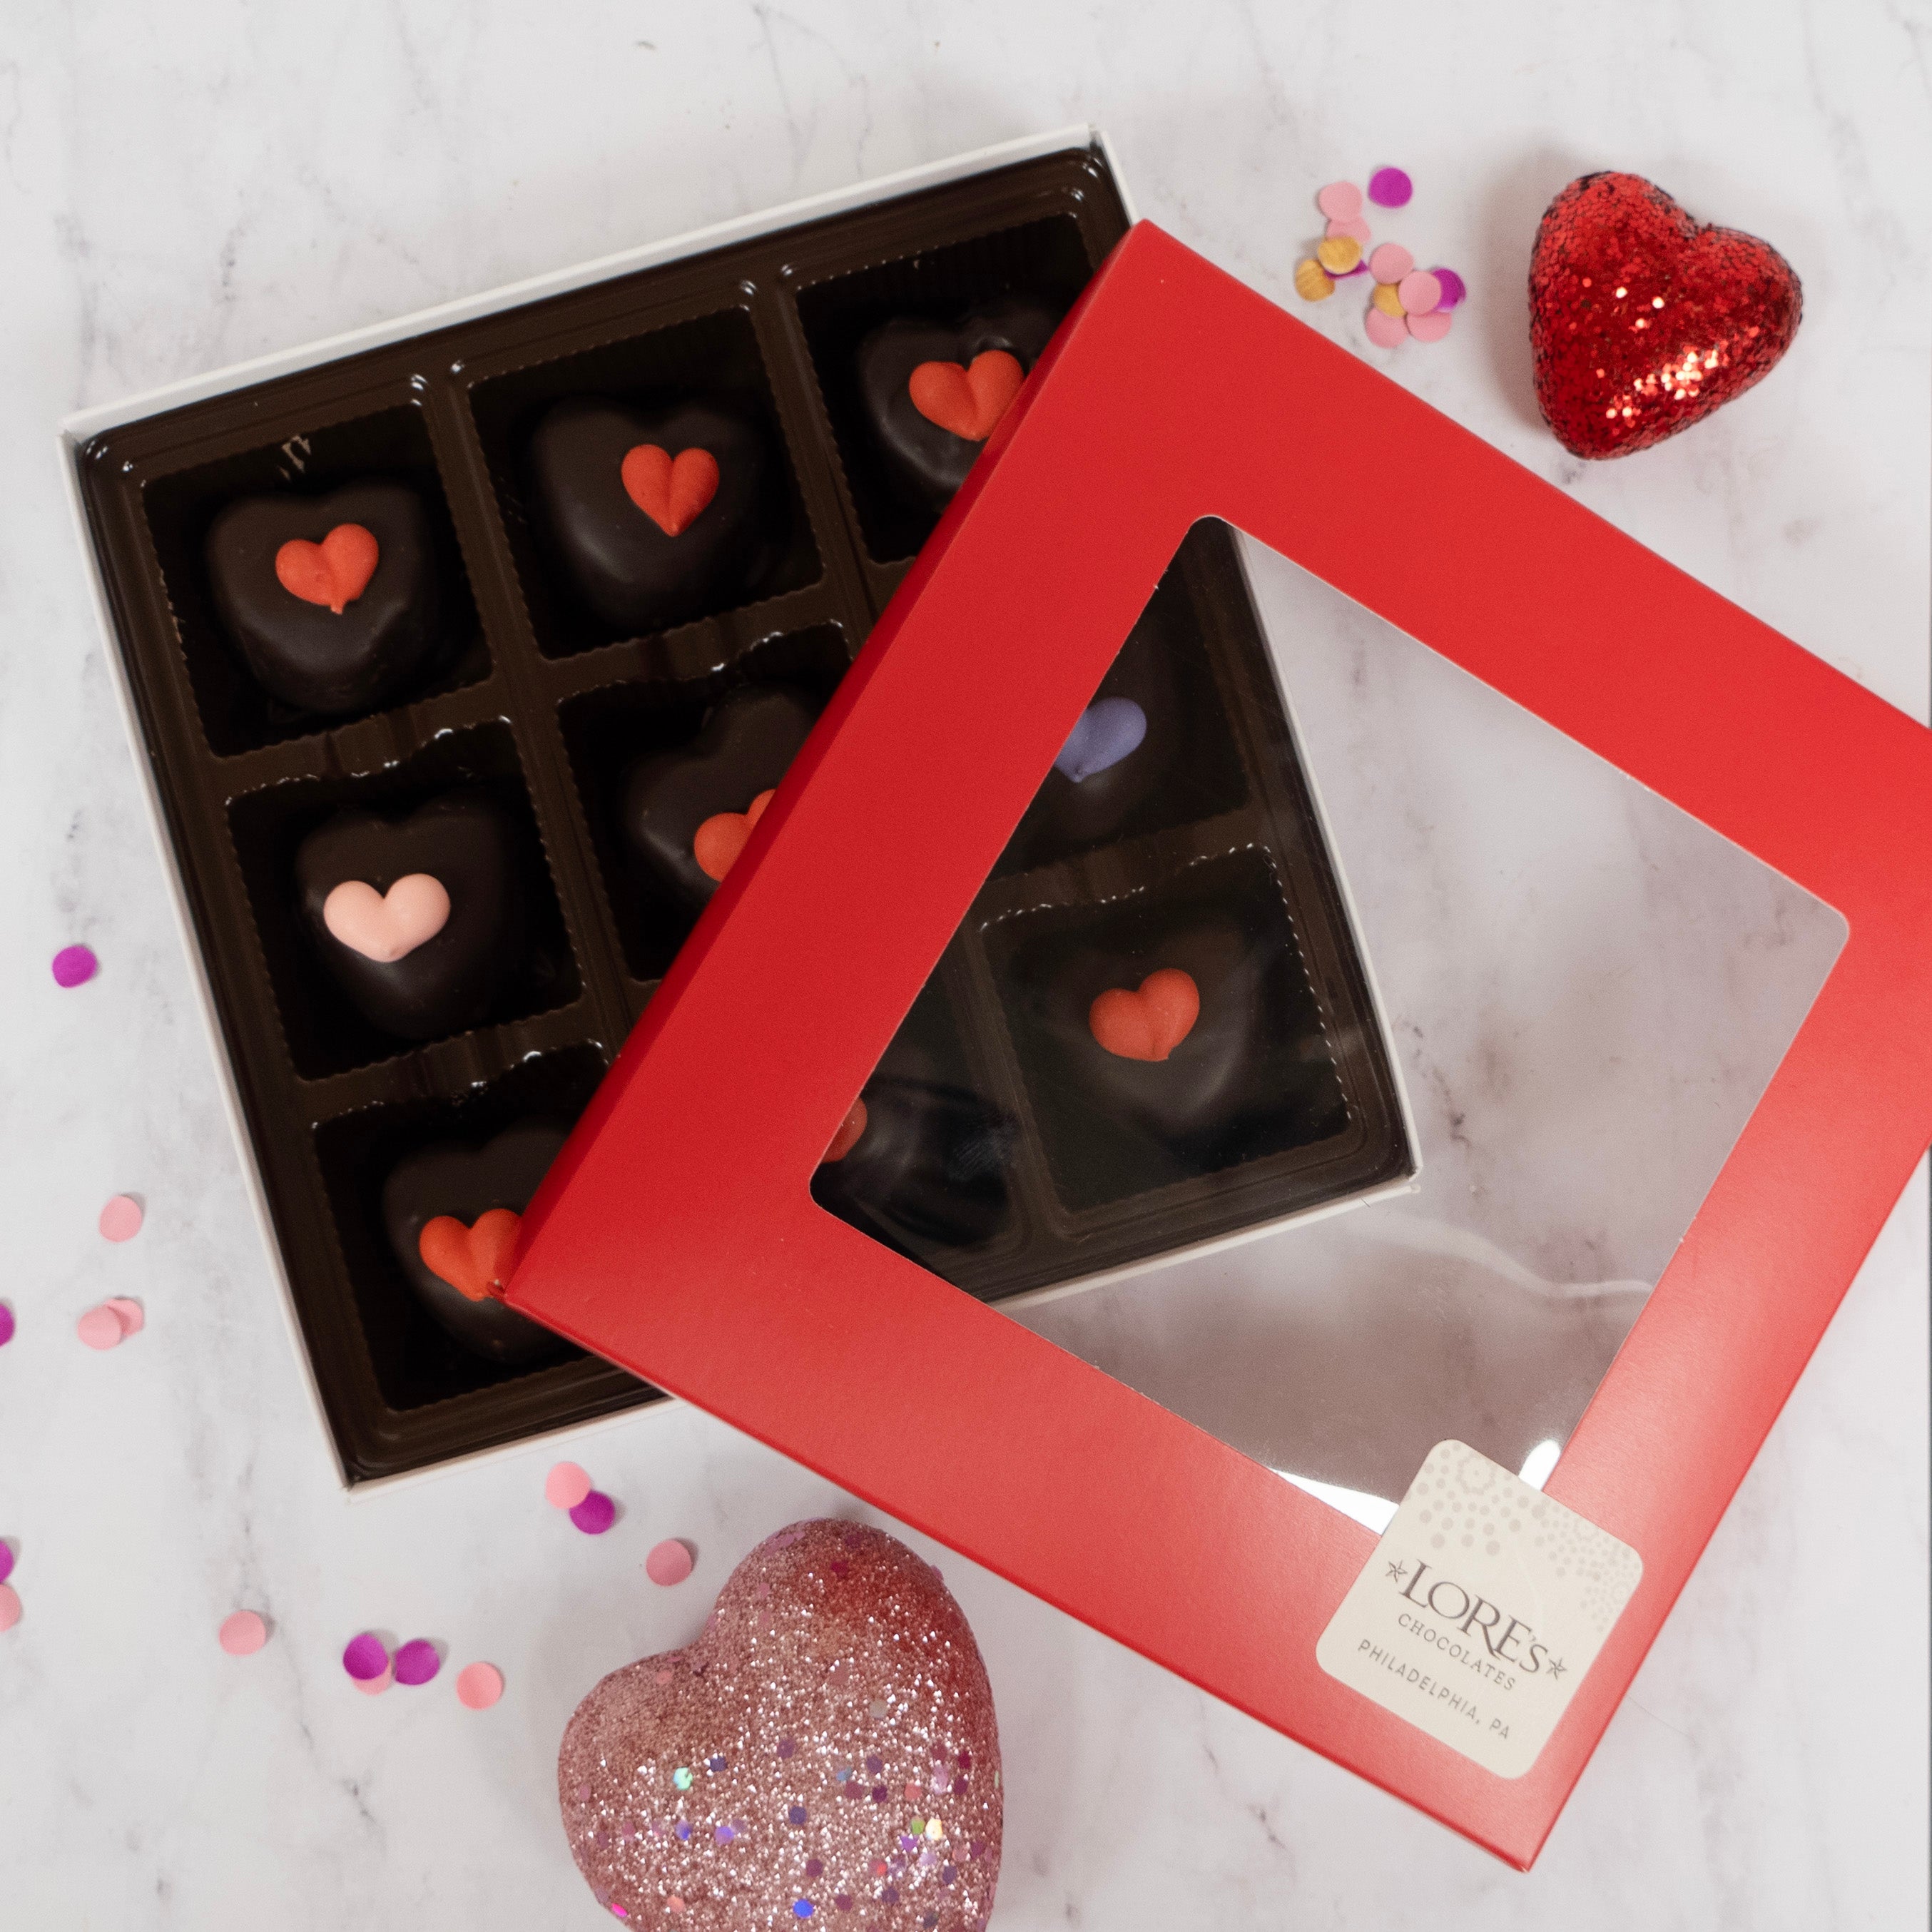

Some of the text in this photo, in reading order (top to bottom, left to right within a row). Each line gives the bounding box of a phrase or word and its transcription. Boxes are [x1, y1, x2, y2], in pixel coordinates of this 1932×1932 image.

[1398, 1613, 1515, 1691] CHOCOLATES
[1399, 1559, 1549, 1674] LORE'S
[1358, 1639, 1509, 1739] PHILADELPHIA, PA
